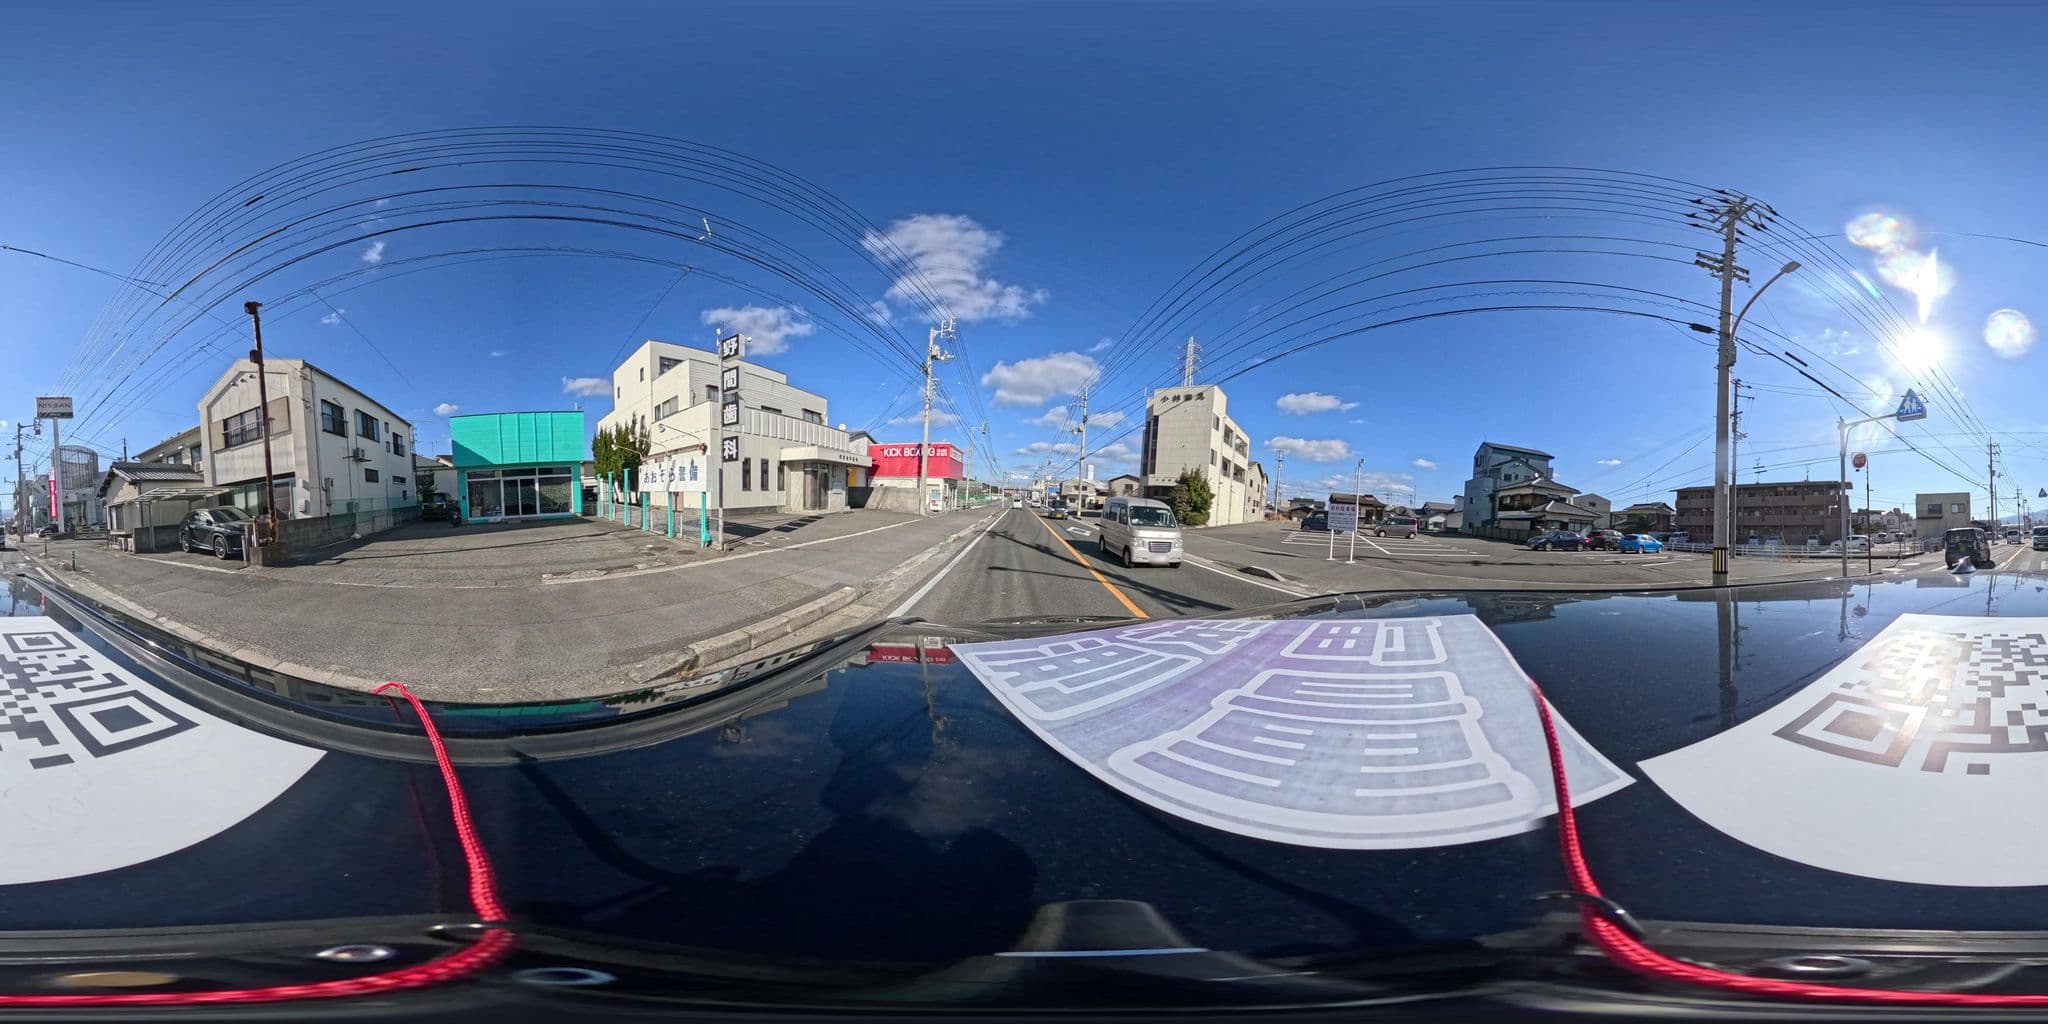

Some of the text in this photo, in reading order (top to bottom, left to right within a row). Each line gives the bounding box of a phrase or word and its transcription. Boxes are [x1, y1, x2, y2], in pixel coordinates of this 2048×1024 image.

[723, 337, 738, 460] 野間歯科
[883, 447, 902, 457] KICK
[904, 447, 935, 457] BOXIG
[971, 634, 1532, 826] 測量
